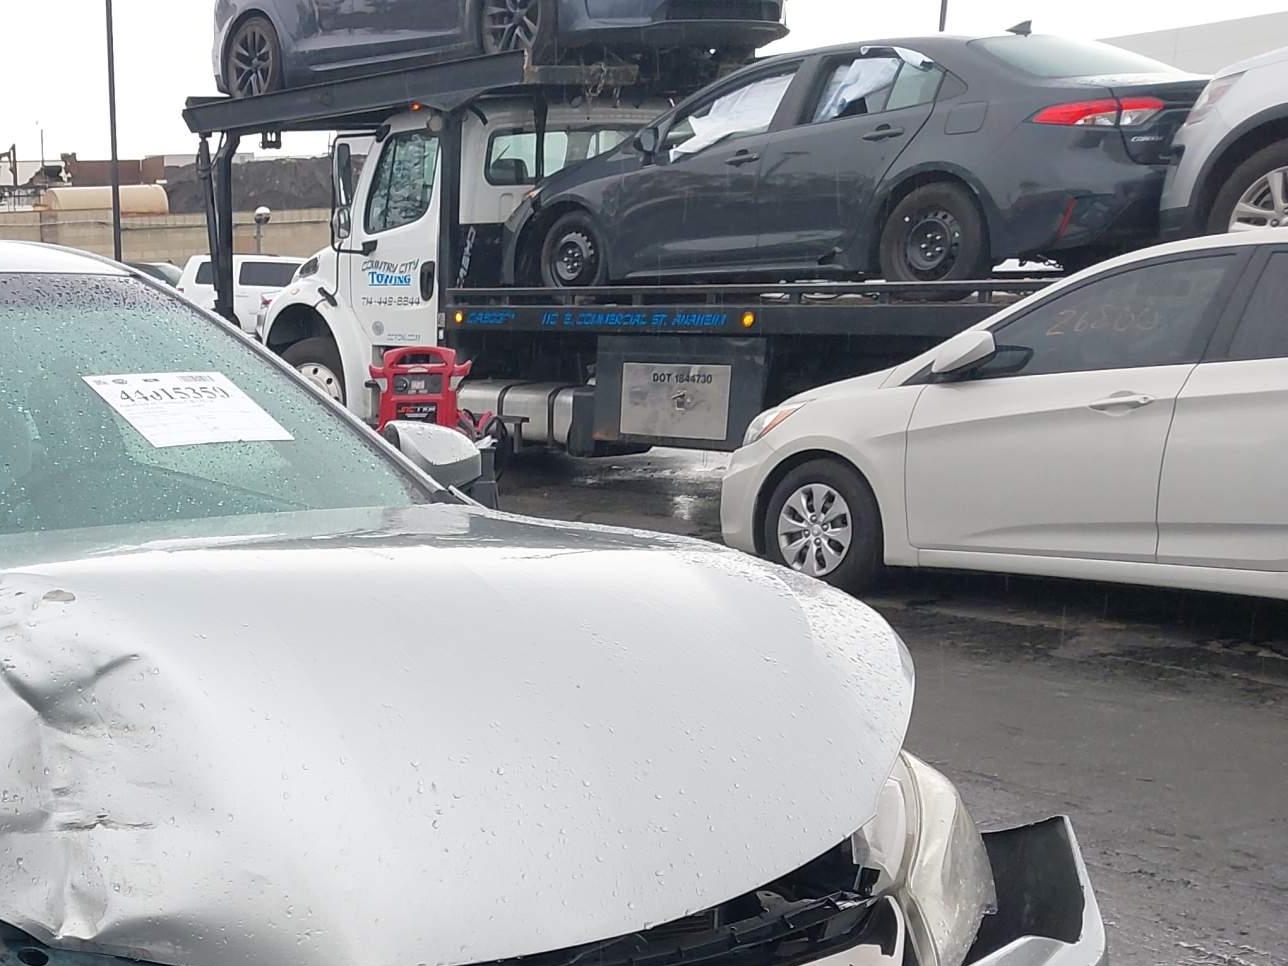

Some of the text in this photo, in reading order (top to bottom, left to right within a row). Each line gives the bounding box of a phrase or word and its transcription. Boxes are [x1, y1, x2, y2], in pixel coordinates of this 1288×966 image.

[399, 258, 419, 273] CITY
[368, 271, 411, 286] TOWING
[652, 373, 672, 383] DOT
